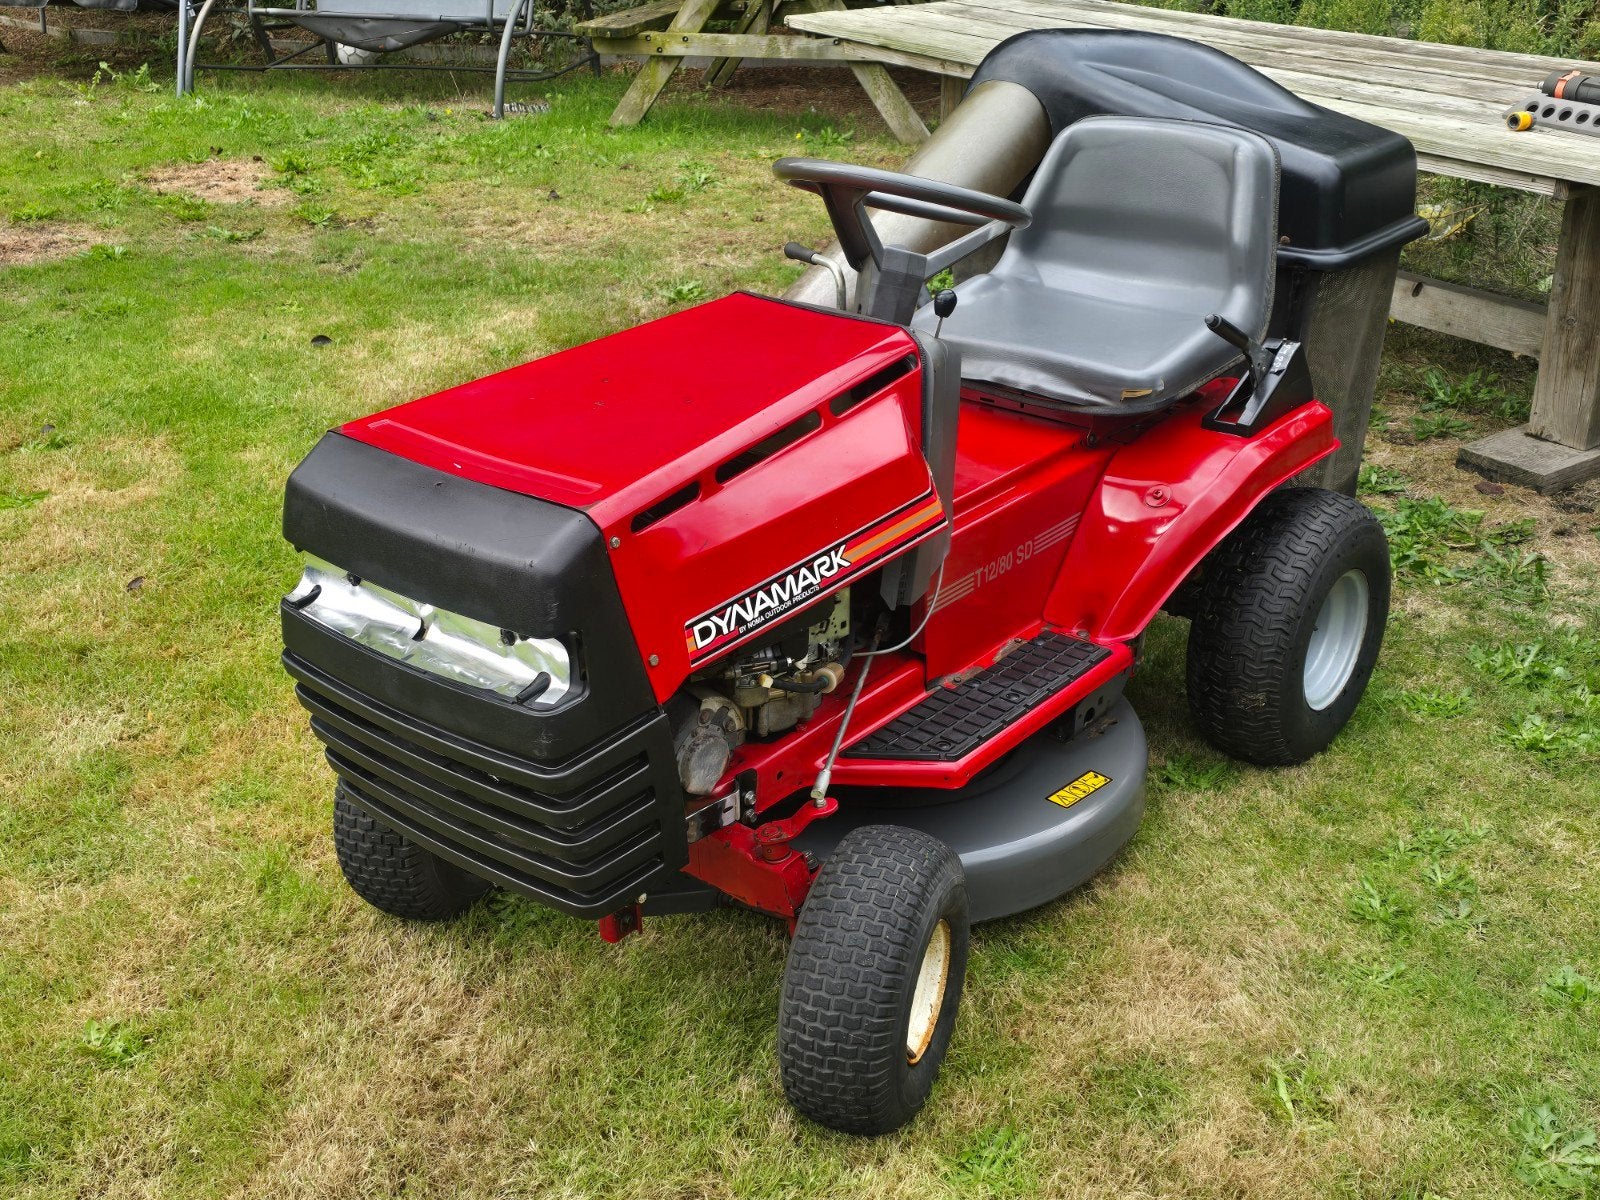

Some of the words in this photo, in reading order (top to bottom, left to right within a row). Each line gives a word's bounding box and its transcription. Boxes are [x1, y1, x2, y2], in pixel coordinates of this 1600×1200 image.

[974, 551, 1013, 587] T12/80
[1016, 540, 1033, 564] SD
[693, 544, 851, 649] DYNAMARK
[738, 626, 747, 634] BY
[747, 617, 765, 628] NOMA
[765, 600, 792, 619] OUTDOOR
[792, 585, 820, 606] PRODUCTS
